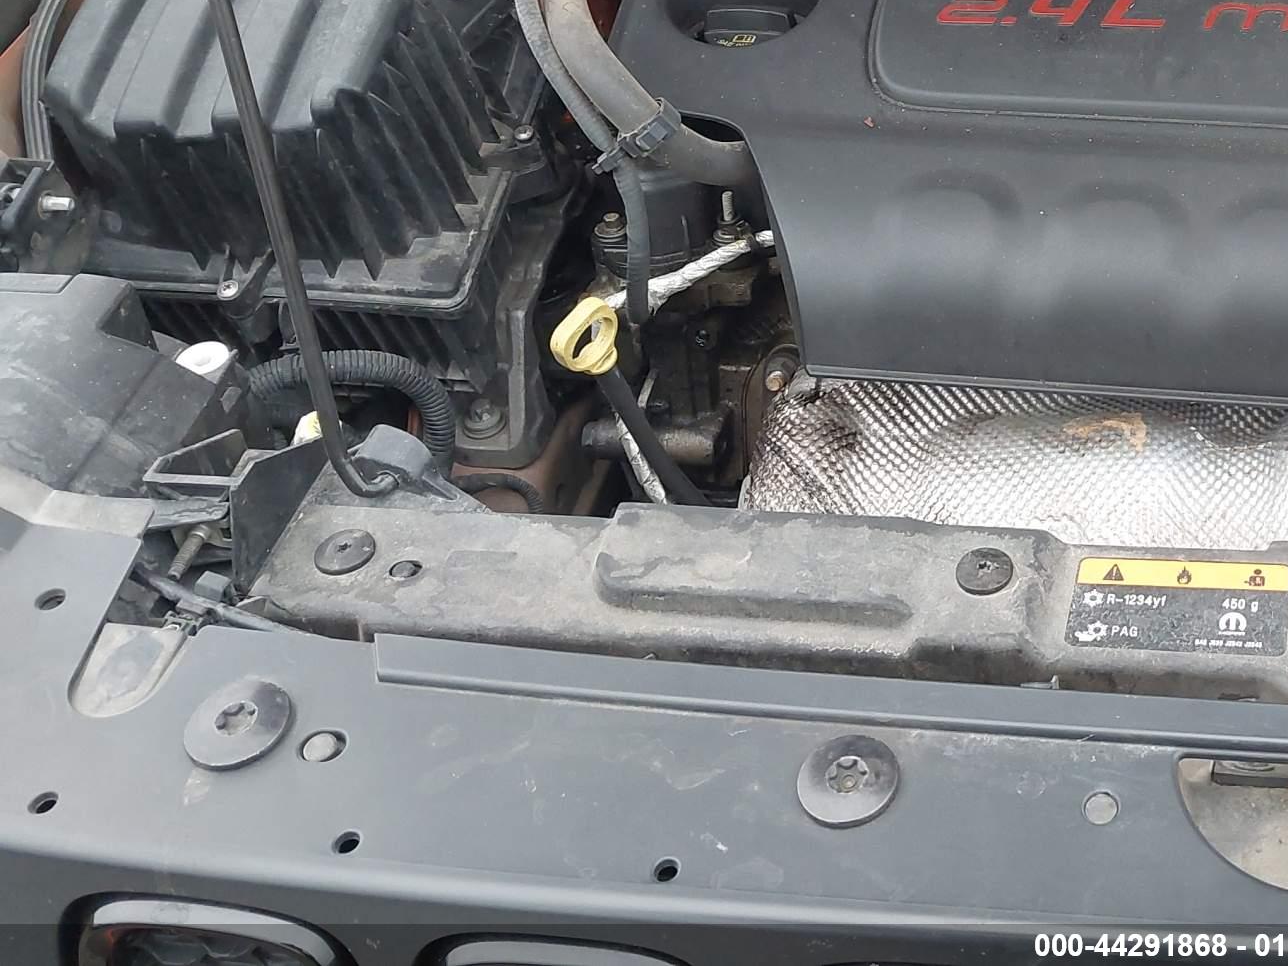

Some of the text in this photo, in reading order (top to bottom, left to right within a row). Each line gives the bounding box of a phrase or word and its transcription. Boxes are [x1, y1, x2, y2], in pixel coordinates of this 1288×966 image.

[1106, 593, 1167, 609] R-1234yf
[1221, 597, 1259, 612] 450 g
[1111, 626, 1138, 638] PAG
